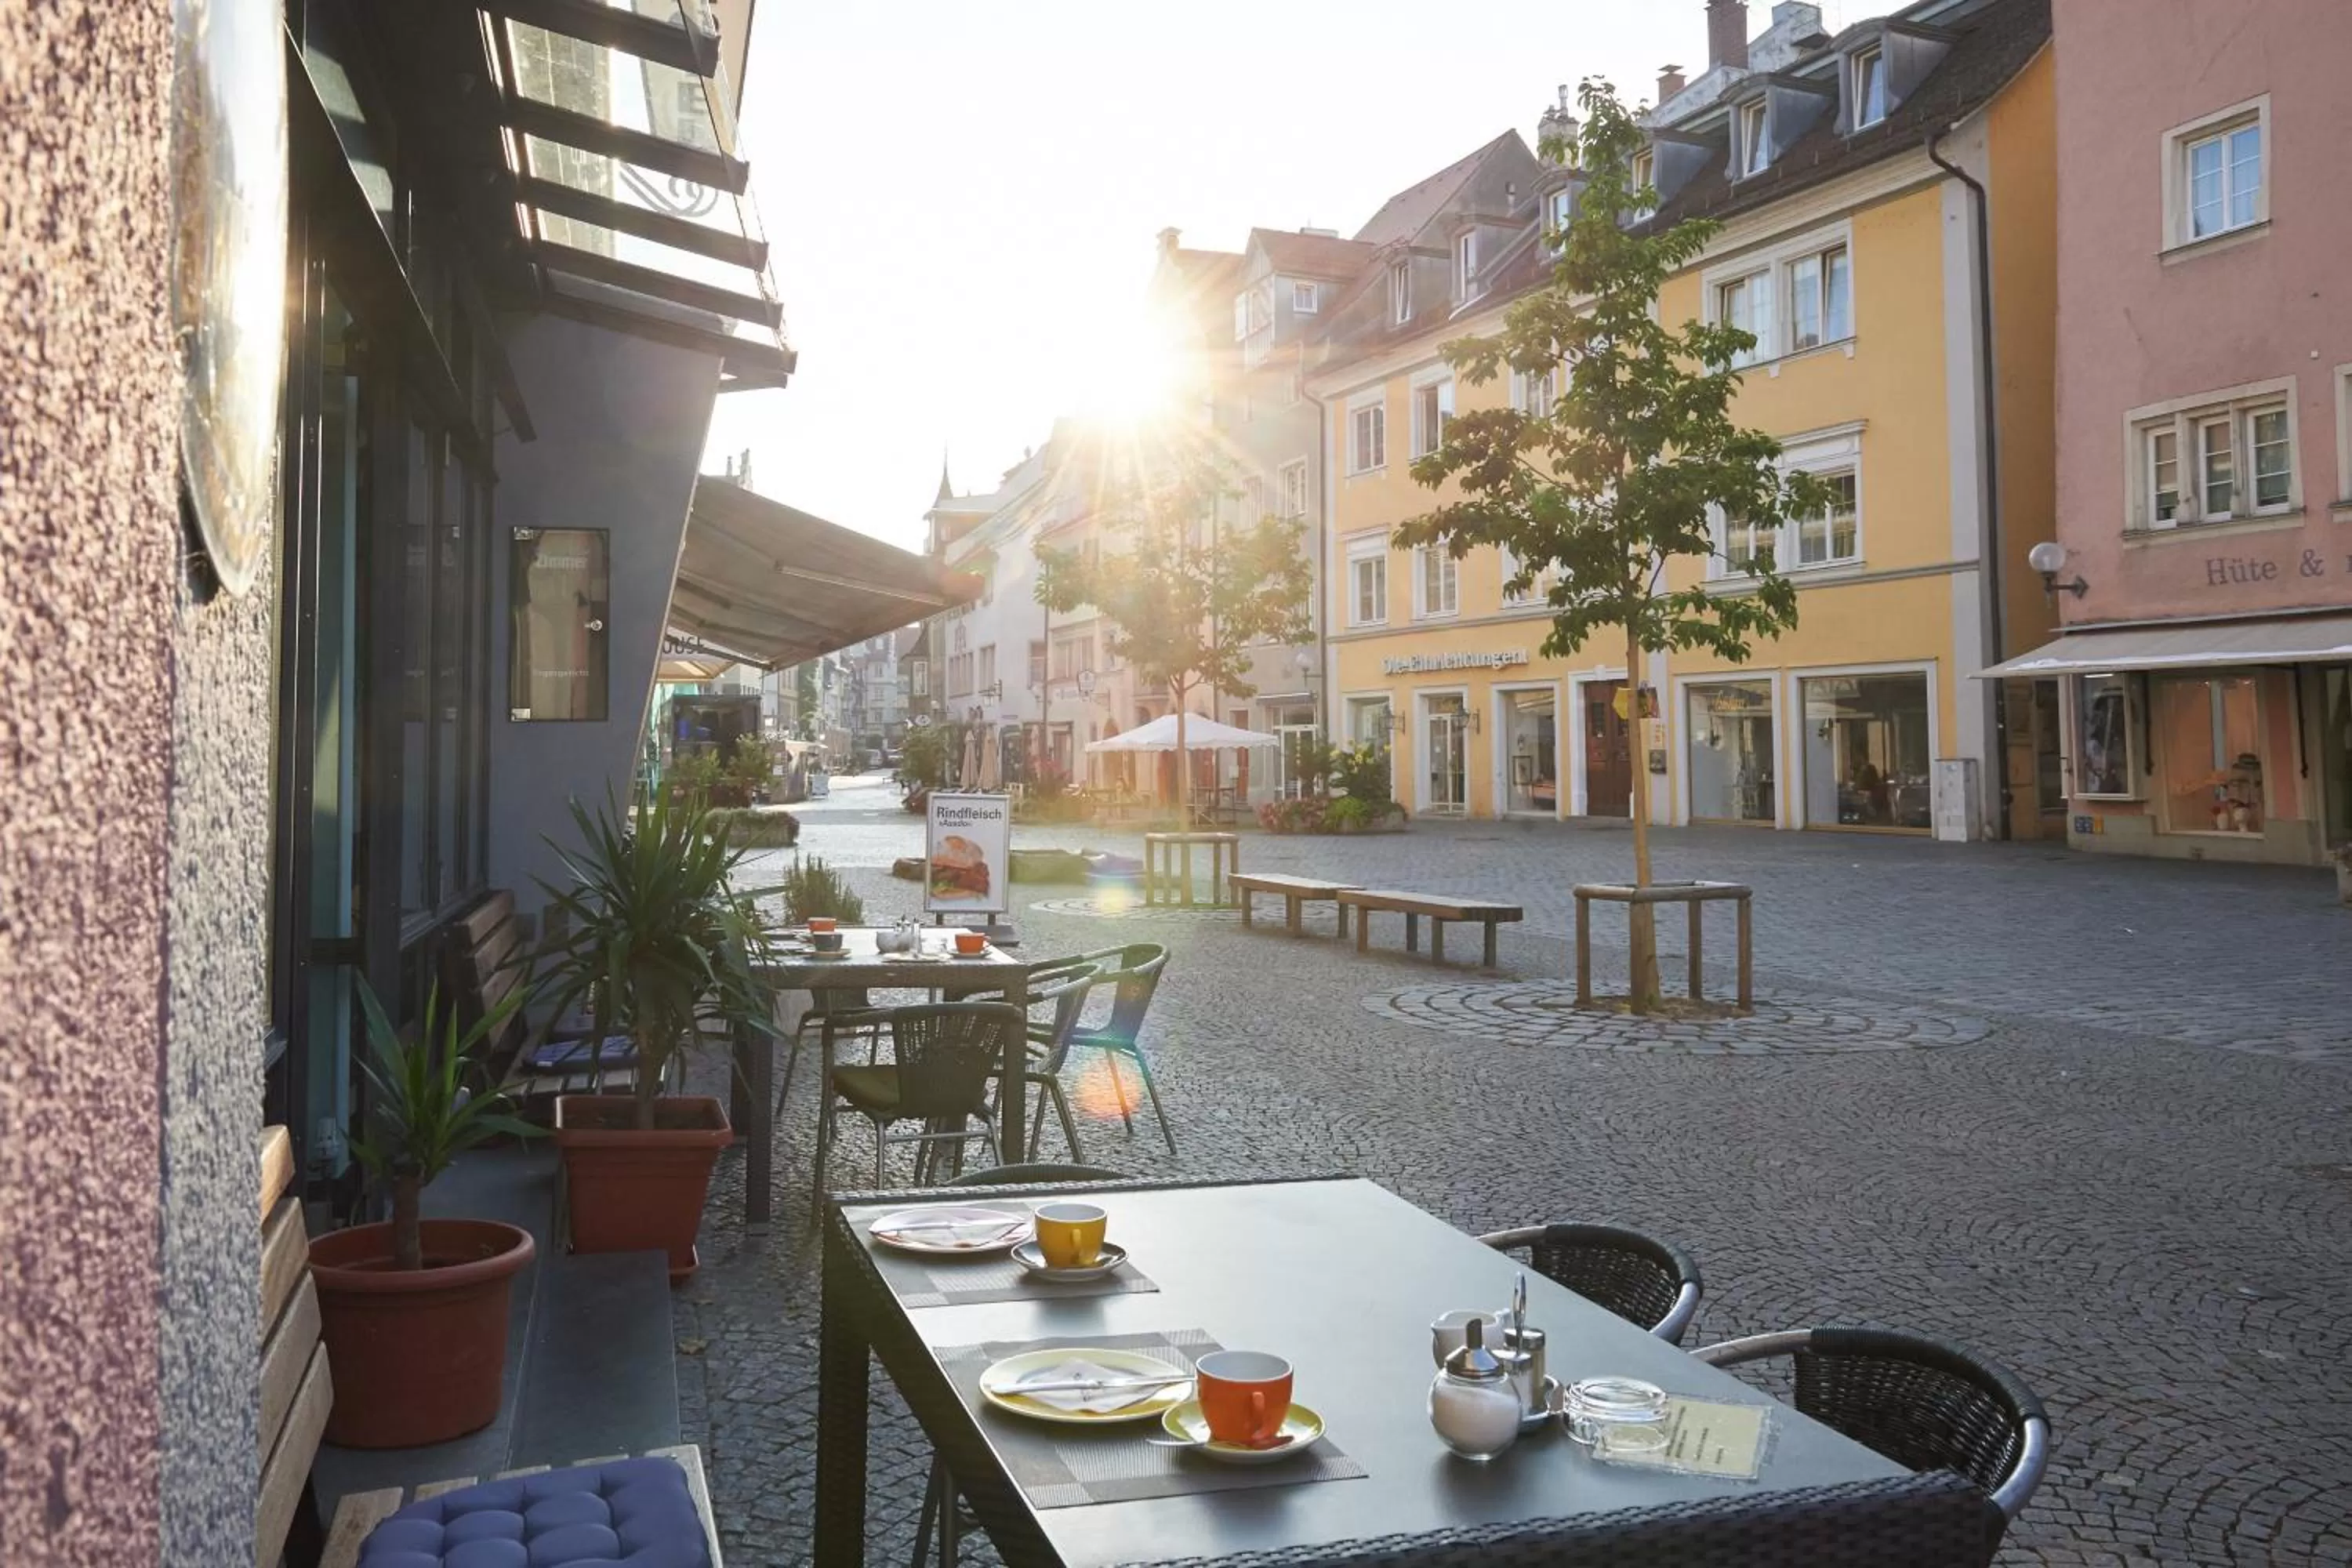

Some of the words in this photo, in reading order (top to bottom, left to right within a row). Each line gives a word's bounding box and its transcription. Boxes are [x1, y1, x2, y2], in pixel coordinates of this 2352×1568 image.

[2205, 557, 2278, 586] Hüte
[2299, 548, 2325, 578] &
[937, 806, 1002, 819] Rindfleisch
